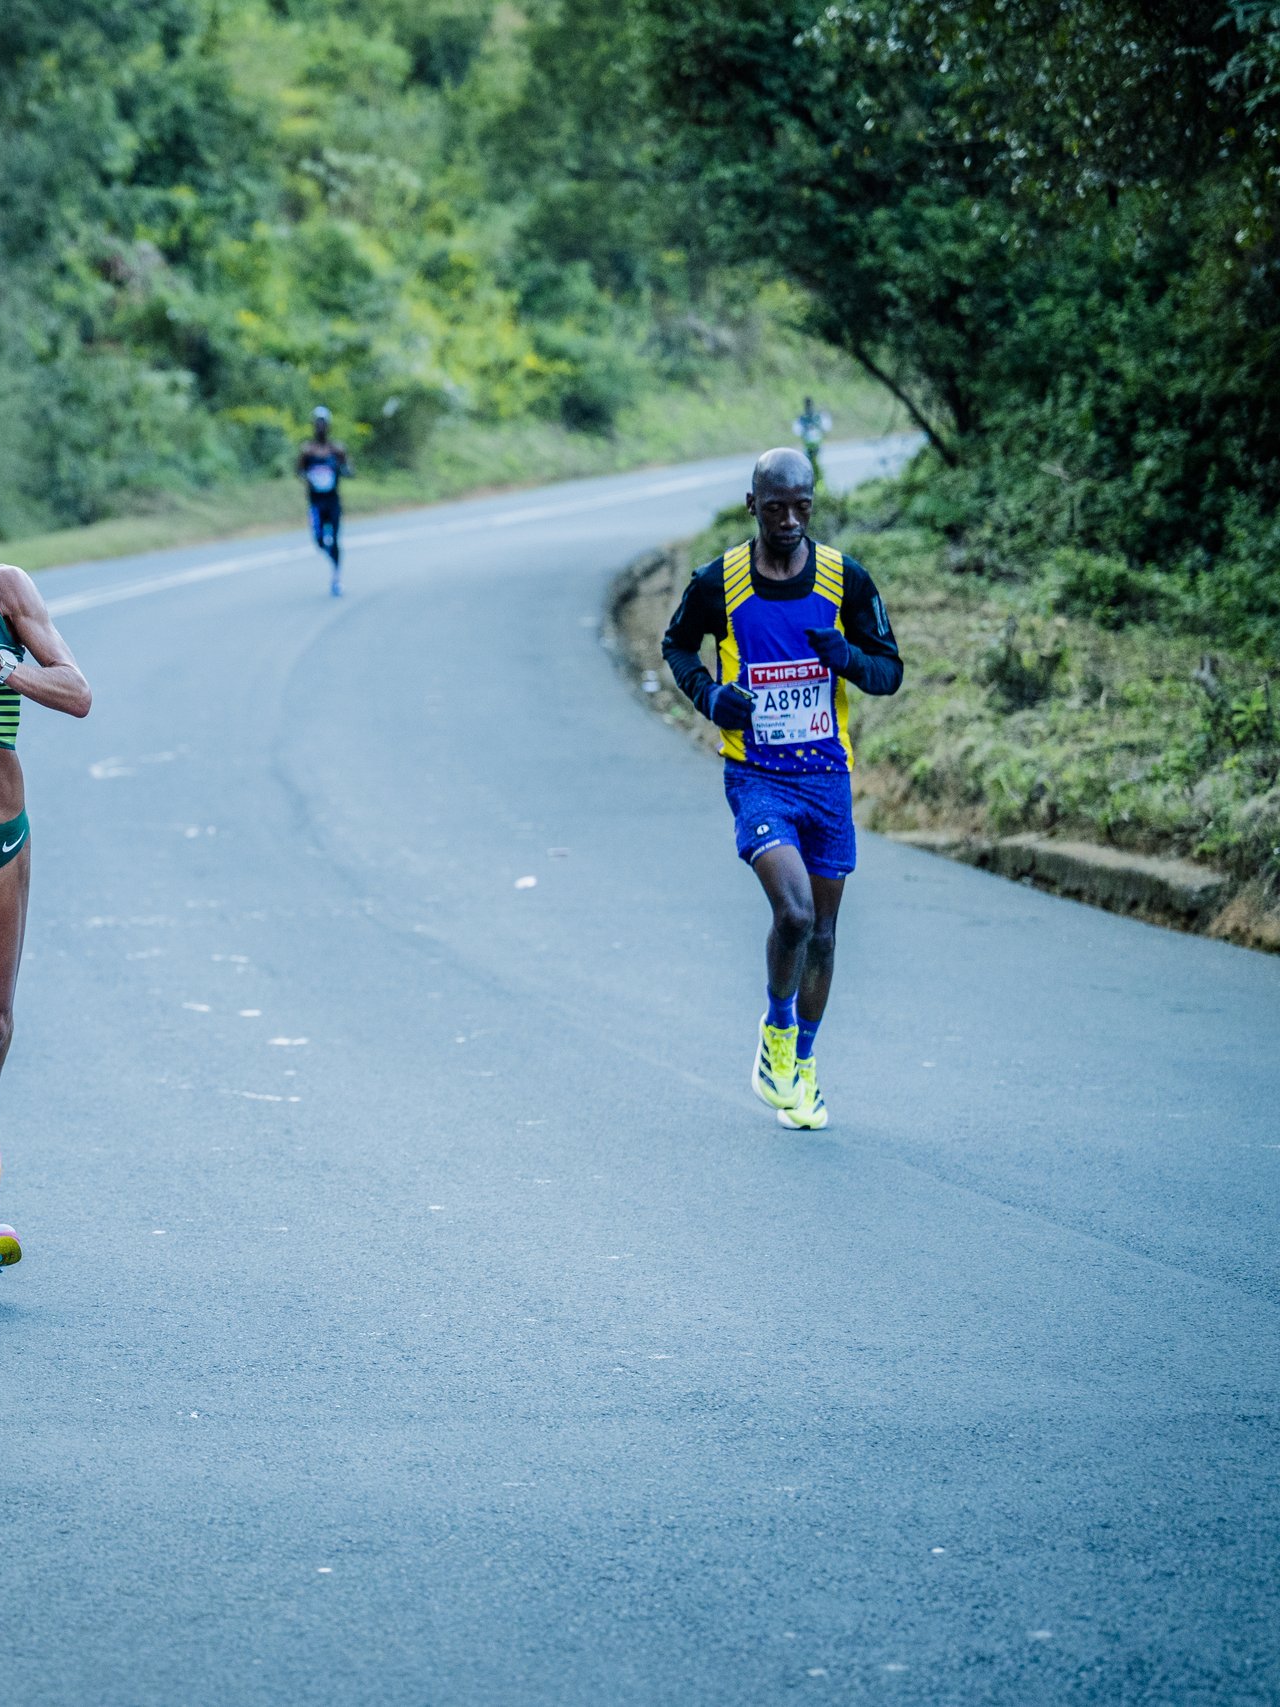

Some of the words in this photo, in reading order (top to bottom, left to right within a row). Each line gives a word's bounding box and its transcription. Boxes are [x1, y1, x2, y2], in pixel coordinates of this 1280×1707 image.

[754, 665, 822, 681] THIRSTI
[764, 686, 820, 712] A8987
[810, 711, 829, 735] 40
